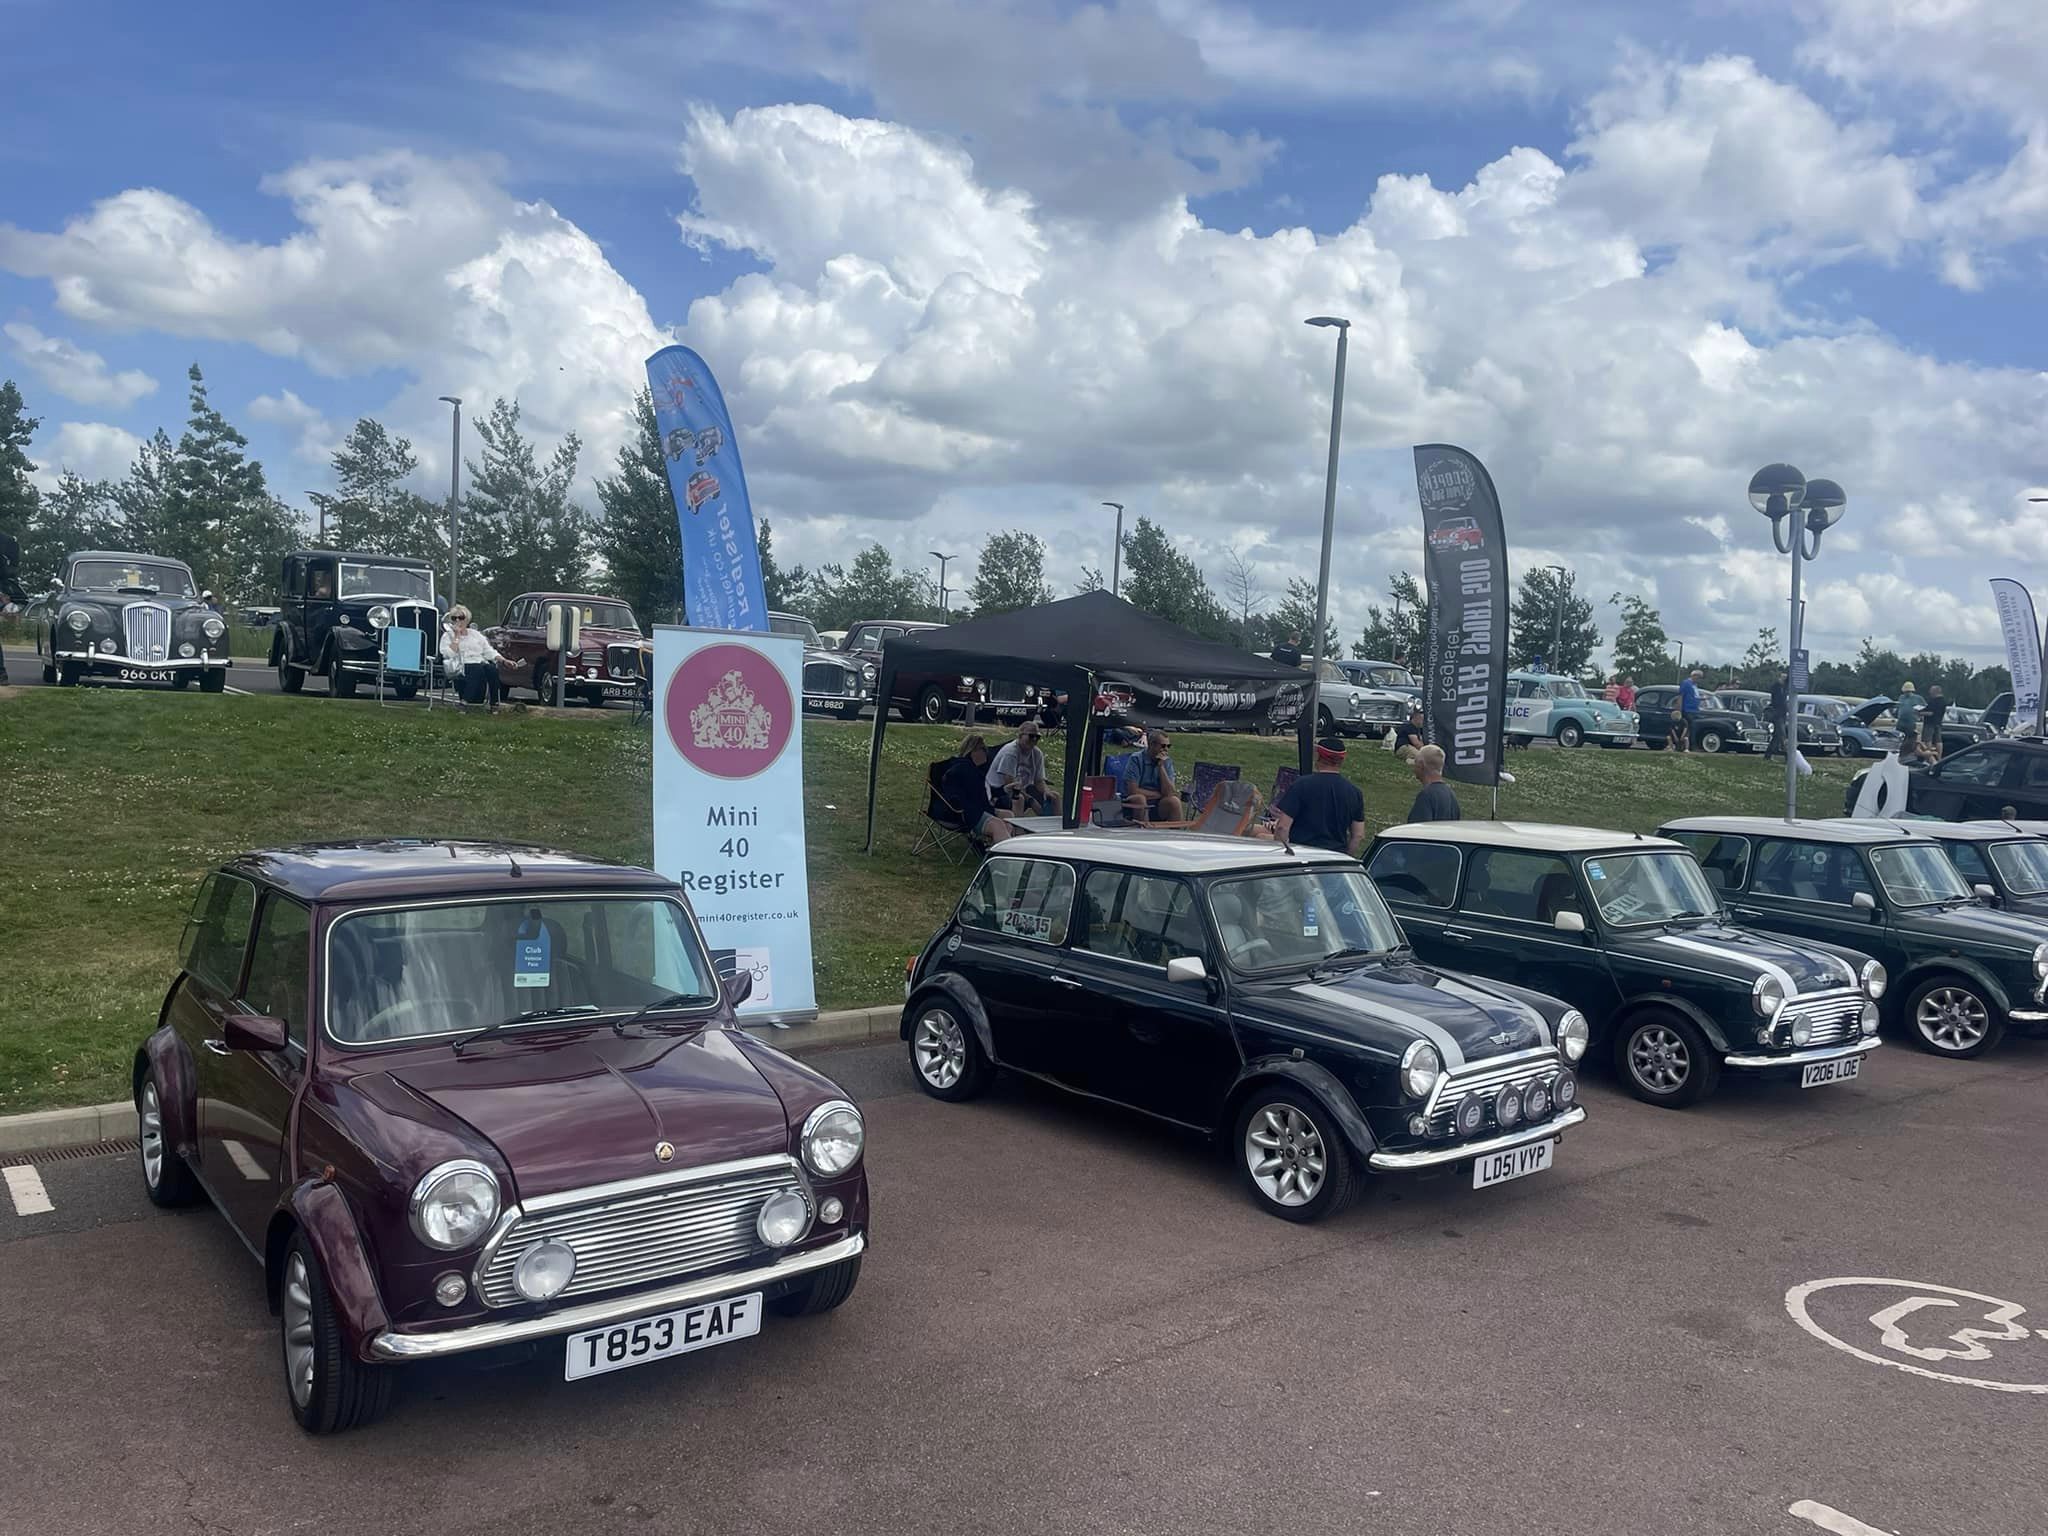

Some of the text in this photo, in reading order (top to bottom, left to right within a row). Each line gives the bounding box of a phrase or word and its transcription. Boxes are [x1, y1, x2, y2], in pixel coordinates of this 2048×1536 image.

[120, 668, 177, 681] 966 CKT
[1178, 681, 1189, 690] The
[1190, 681, 1206, 691] Final
[1158, 690, 1210, 710] COOPER
[1210, 691, 1239, 711] SPORT
[720, 715, 745, 725] MINI
[1504, 706, 1530, 718] LICE
[723, 727, 743, 742] 40
[707, 806, 758, 827] Mini
[720, 837, 749, 858] 40
[681, 870, 784, 895] Register
[525, 946, 542, 954] Club
[1806, 1059, 1858, 1084] V206 LOE
[1483, 1145, 1546, 1182] LD51 VYP
[584, 1299, 748, 1368] T853 EAF
